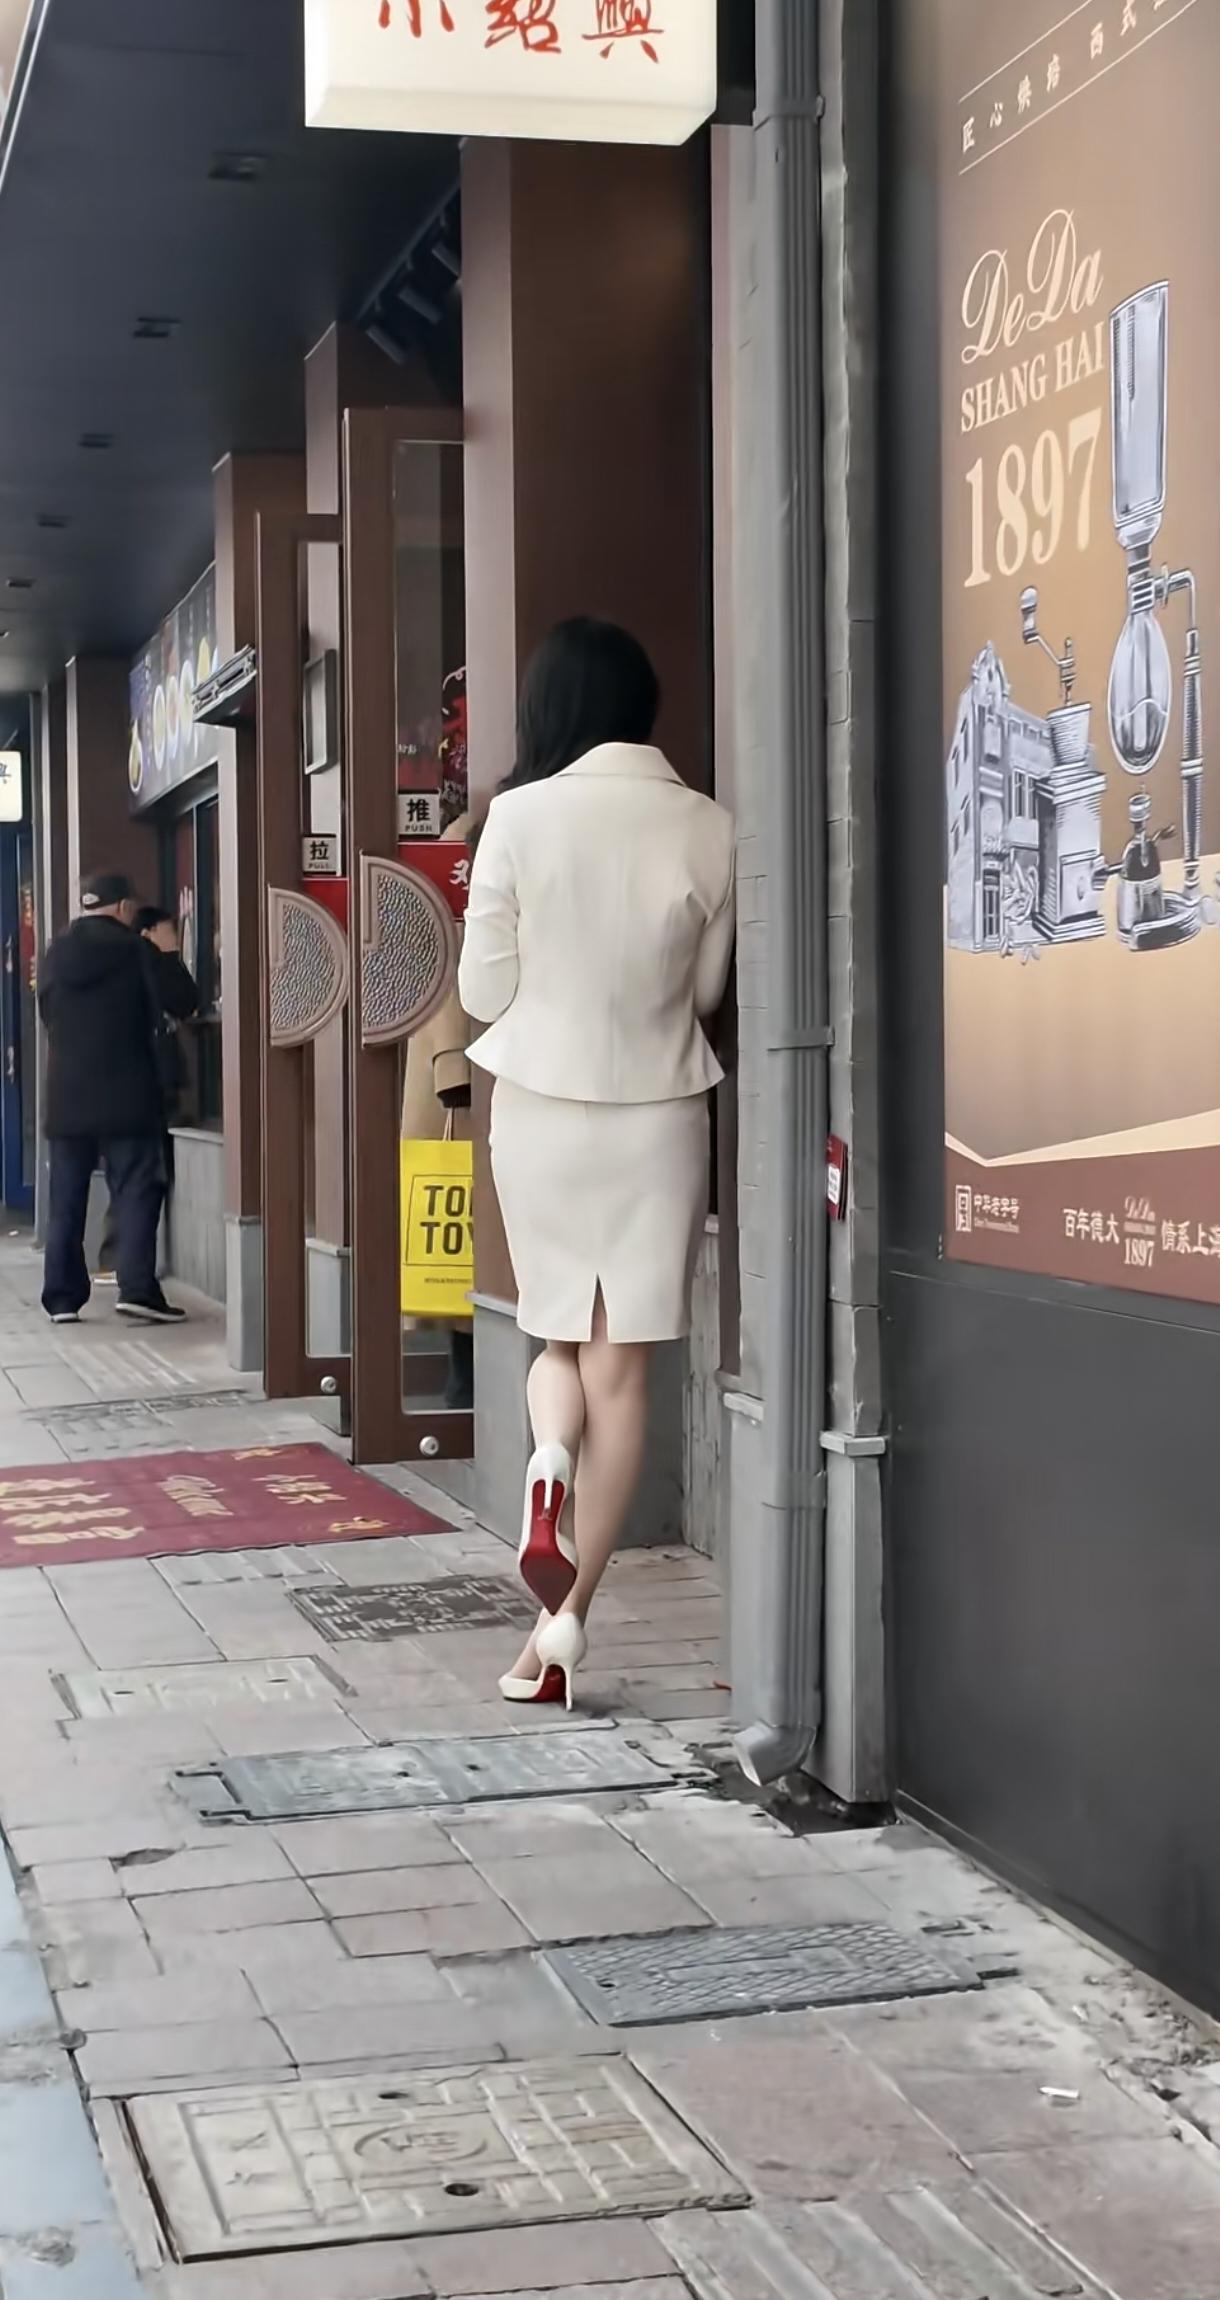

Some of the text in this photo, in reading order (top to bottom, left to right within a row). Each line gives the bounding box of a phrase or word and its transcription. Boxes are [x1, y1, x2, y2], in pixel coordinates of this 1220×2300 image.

[961, 320, 1105, 436] SHANG HAI
[964, 406, 1102, 588] 1897
[406, 798, 431, 822] 推
[310, 841, 329, 861] 拉
[424, 1185, 473, 1217] TO
[1124, 1237, 1155, 1267] 1897
